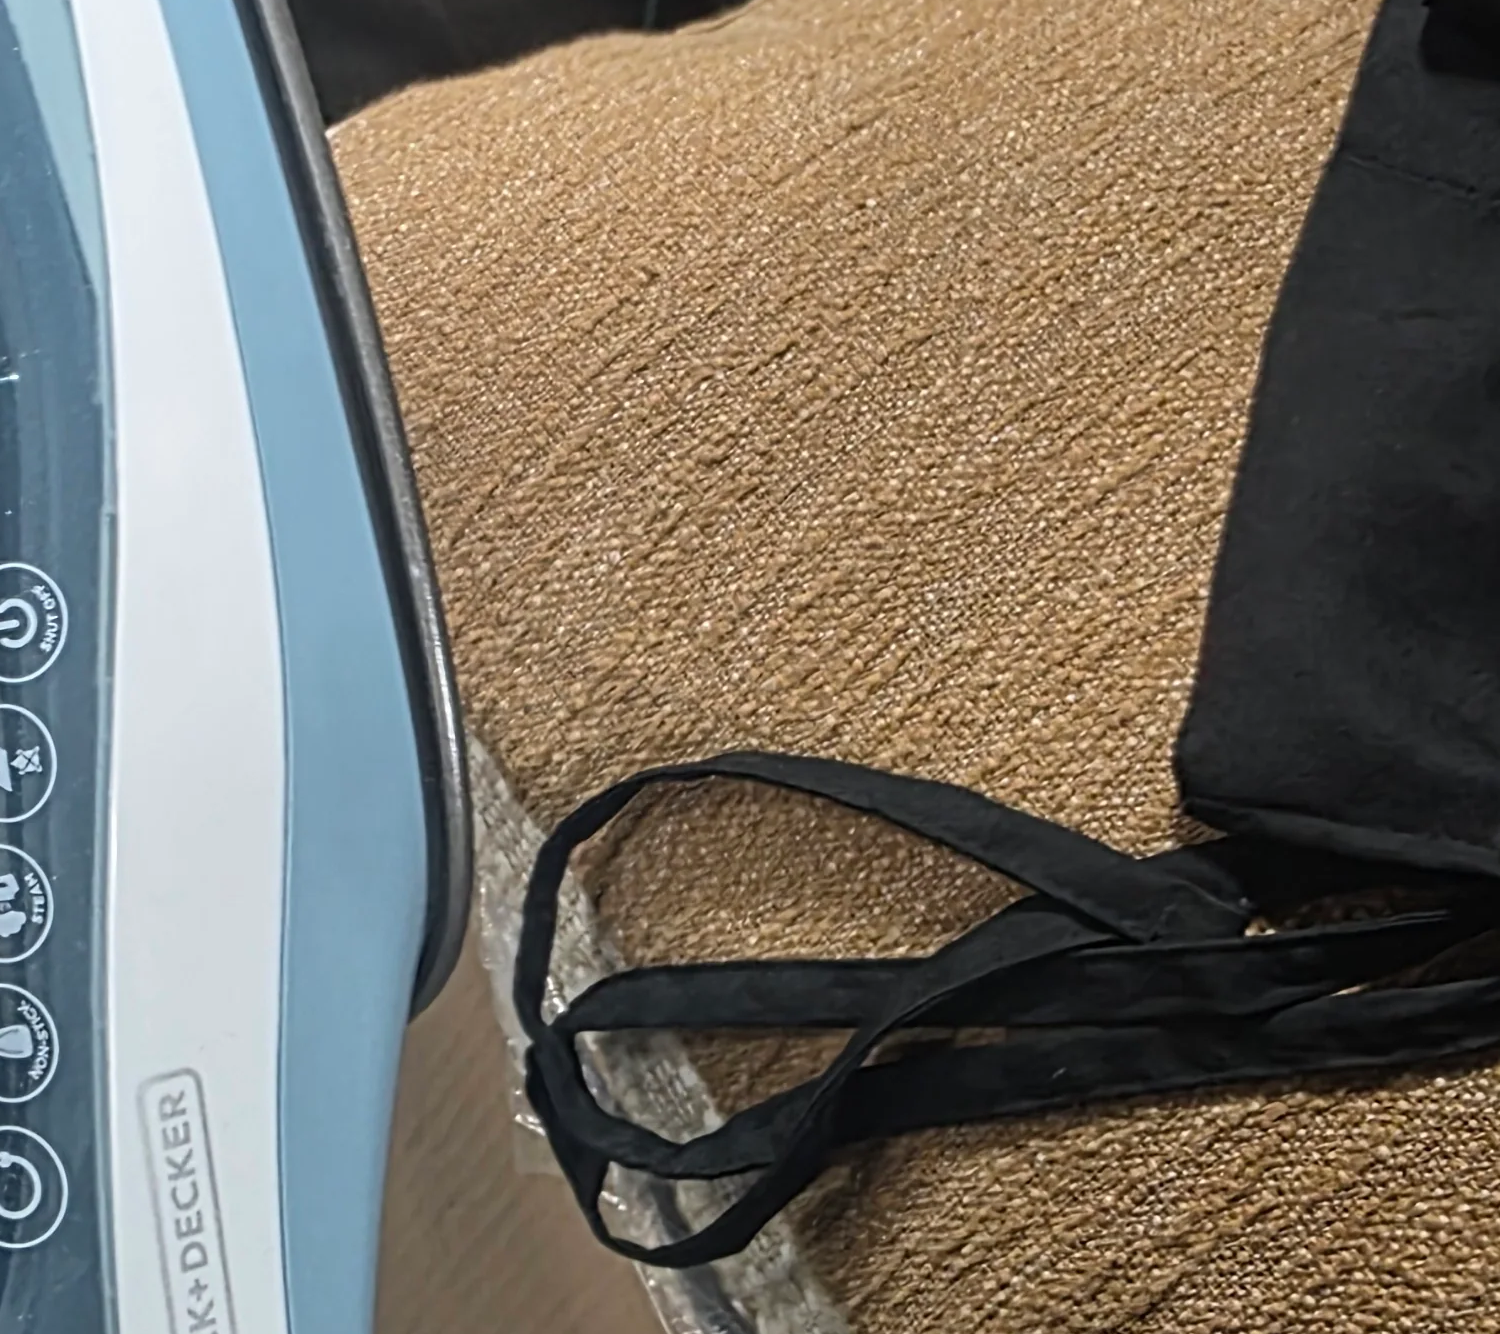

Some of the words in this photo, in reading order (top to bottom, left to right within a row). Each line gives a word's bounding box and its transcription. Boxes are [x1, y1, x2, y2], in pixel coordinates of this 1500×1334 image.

[30, 585, 56, 611] OFF
[40, 613, 59, 654] SHUT
[24, 872, 45, 925] STEAM
[17, 999, 50, 1080] NON-STICK
